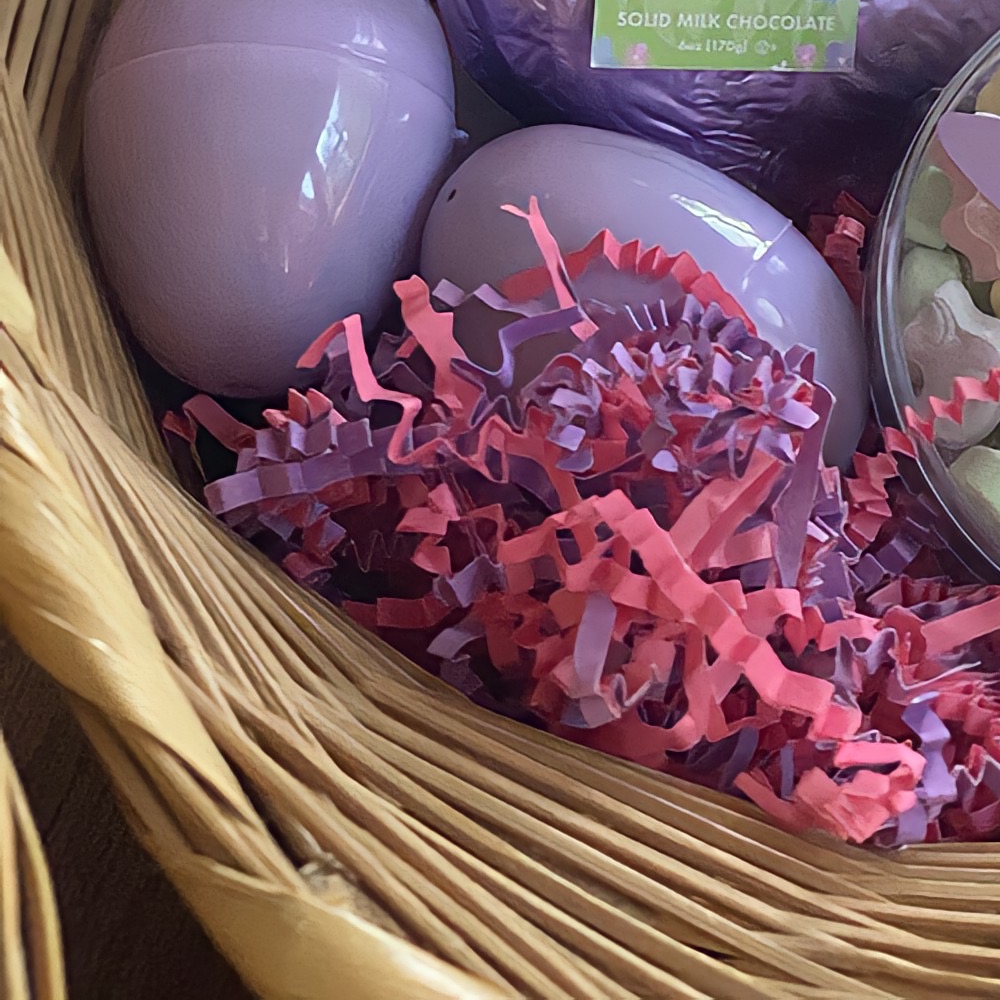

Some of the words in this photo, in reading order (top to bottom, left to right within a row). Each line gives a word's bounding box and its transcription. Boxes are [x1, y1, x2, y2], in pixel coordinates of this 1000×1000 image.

[617, 11, 672, 28] SOLID
[677, 13, 721, 29] MILK
[726, 15, 836, 32] CHOCOLATE
